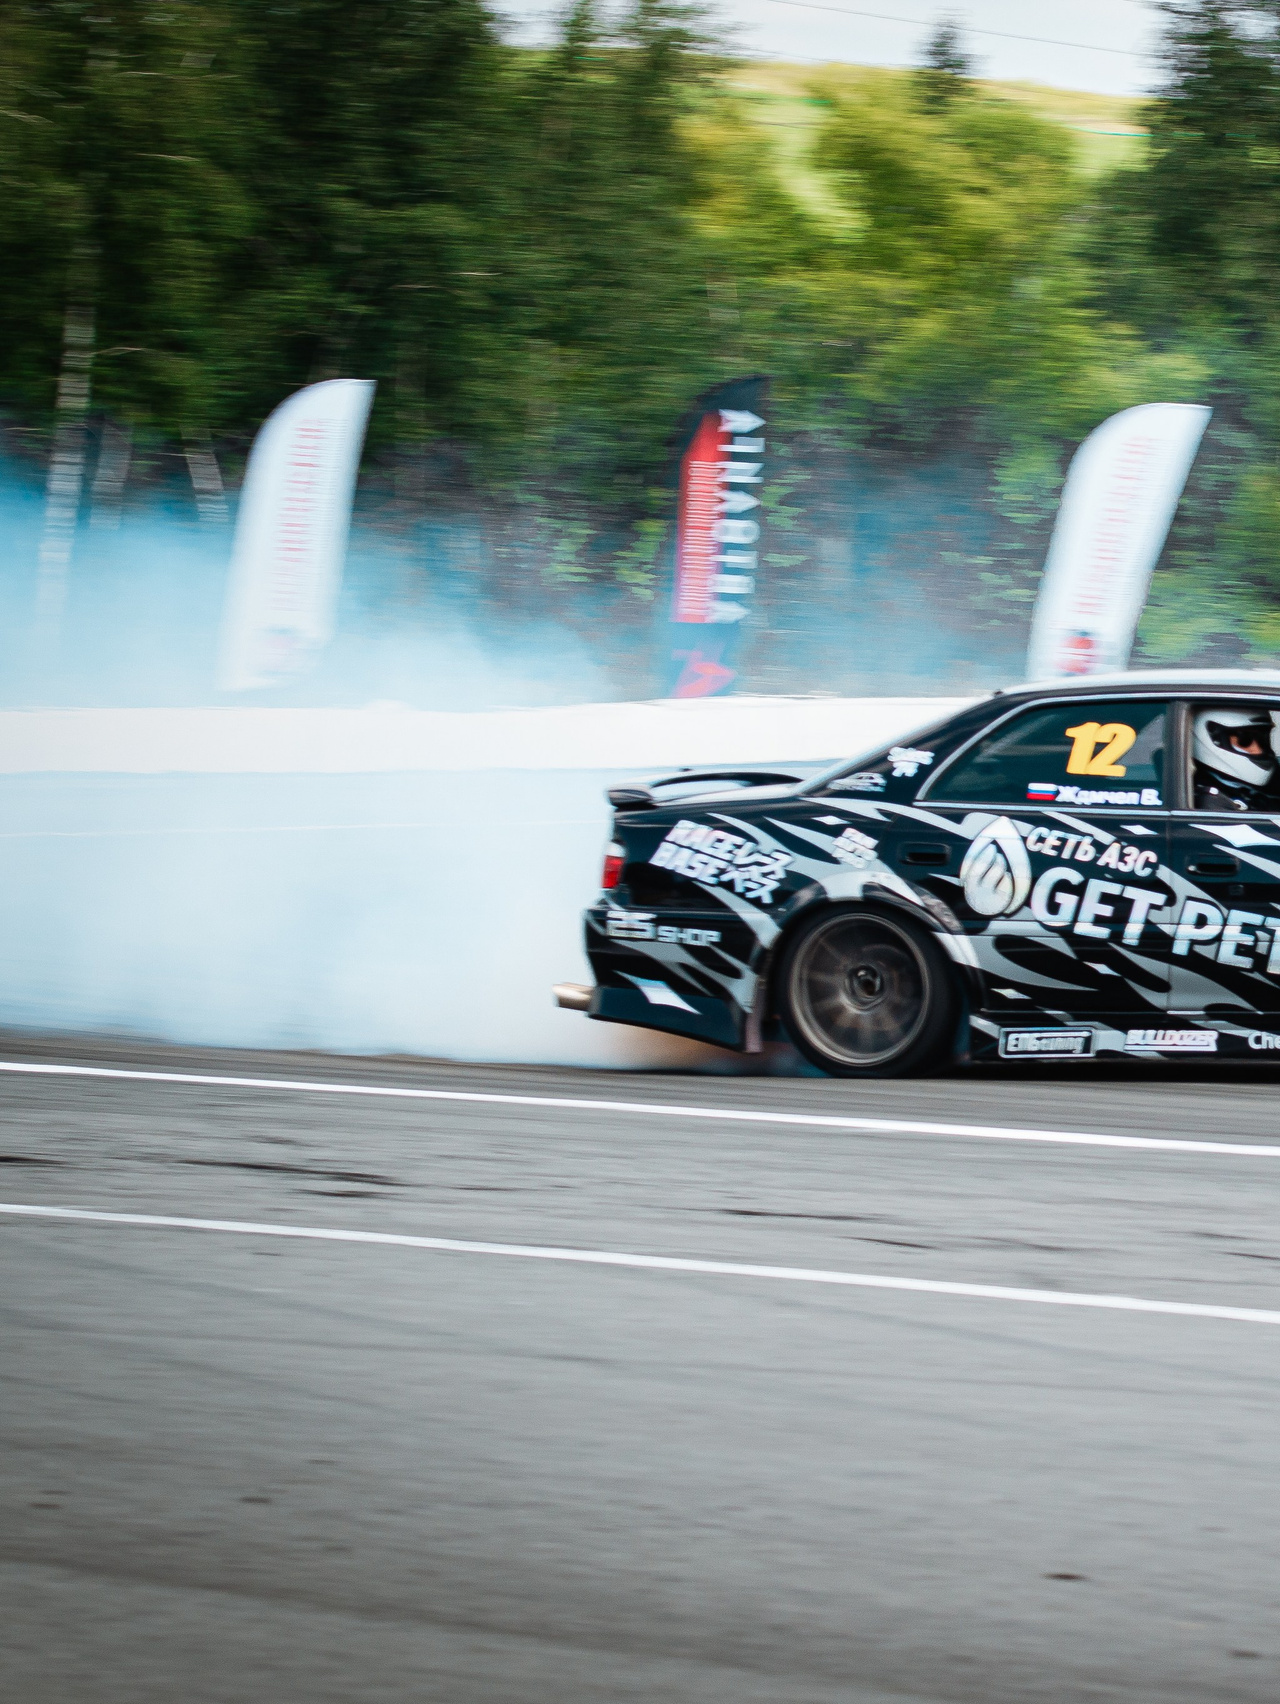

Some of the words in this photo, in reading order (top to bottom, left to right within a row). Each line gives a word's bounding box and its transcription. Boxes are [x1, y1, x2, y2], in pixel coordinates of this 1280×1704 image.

[1065, 722, 1136, 777] 12
[1026, 827, 1096, 861] СЕТЬ
[1096, 842, 1157, 877] АЗС
[1031, 867, 1167, 946] GET
[657, 925, 722, 946] SHOP
